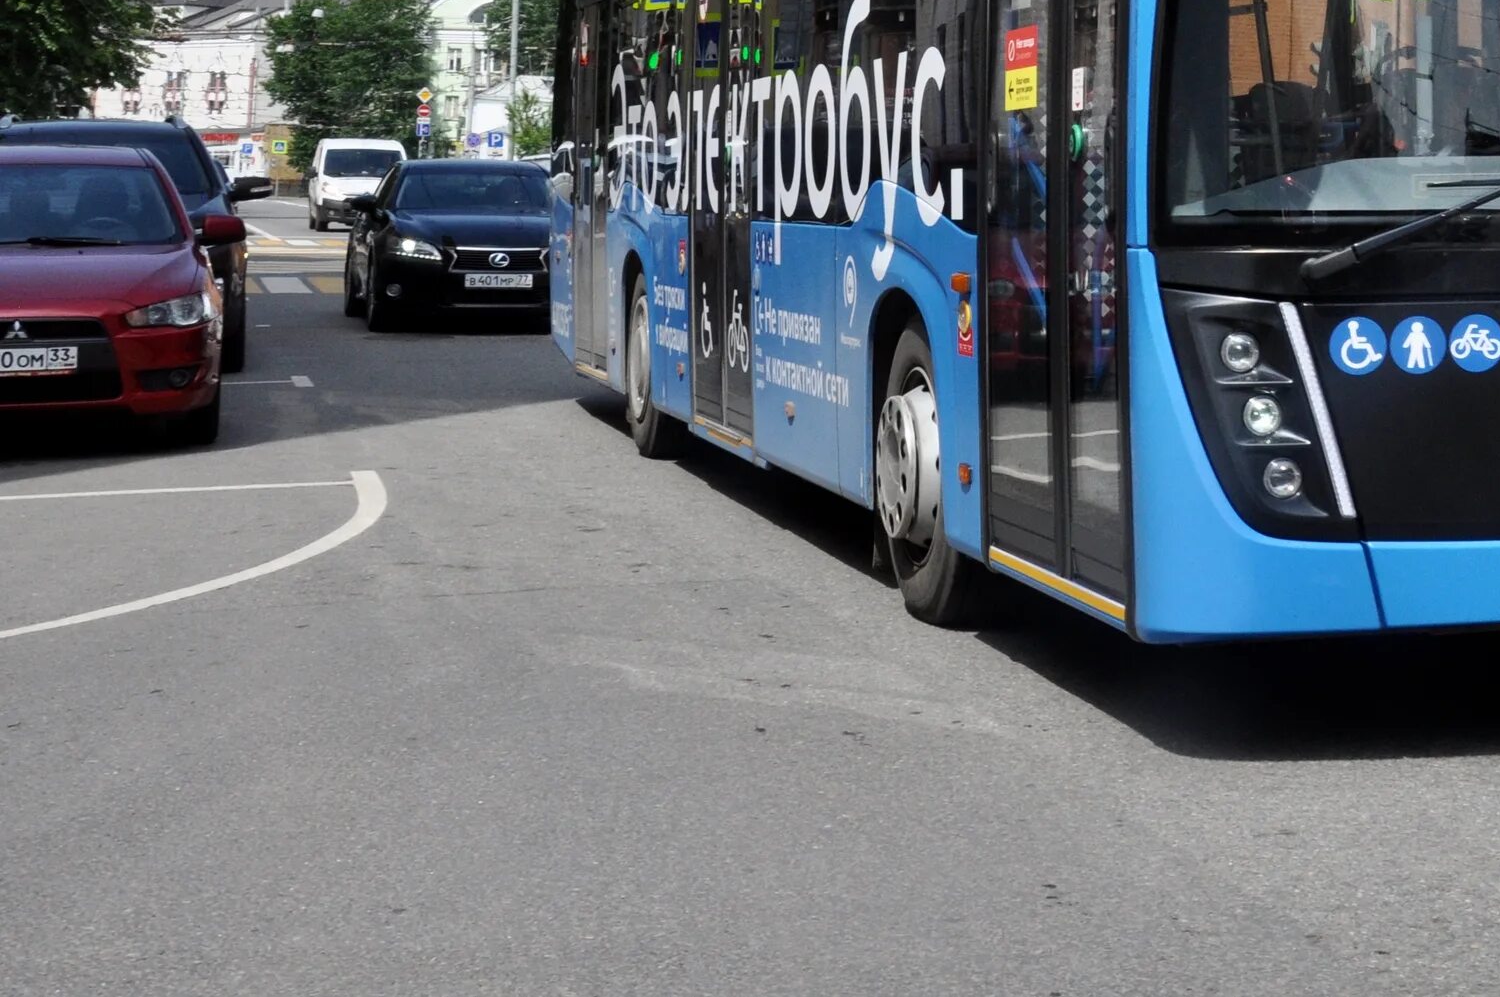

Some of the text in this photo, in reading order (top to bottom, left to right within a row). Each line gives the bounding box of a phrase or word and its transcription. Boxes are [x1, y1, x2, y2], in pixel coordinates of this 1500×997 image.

[608, 64, 658, 215] Это
[517, 274, 529, 284] 77
[764, 297, 777, 336] Не
[777, 308, 822, 346] привязан
[49, 348, 71, 362] 33
[765, 357, 771, 382] к
[772, 361, 825, 399] контактной
[825, 370, 849, 408] сети
